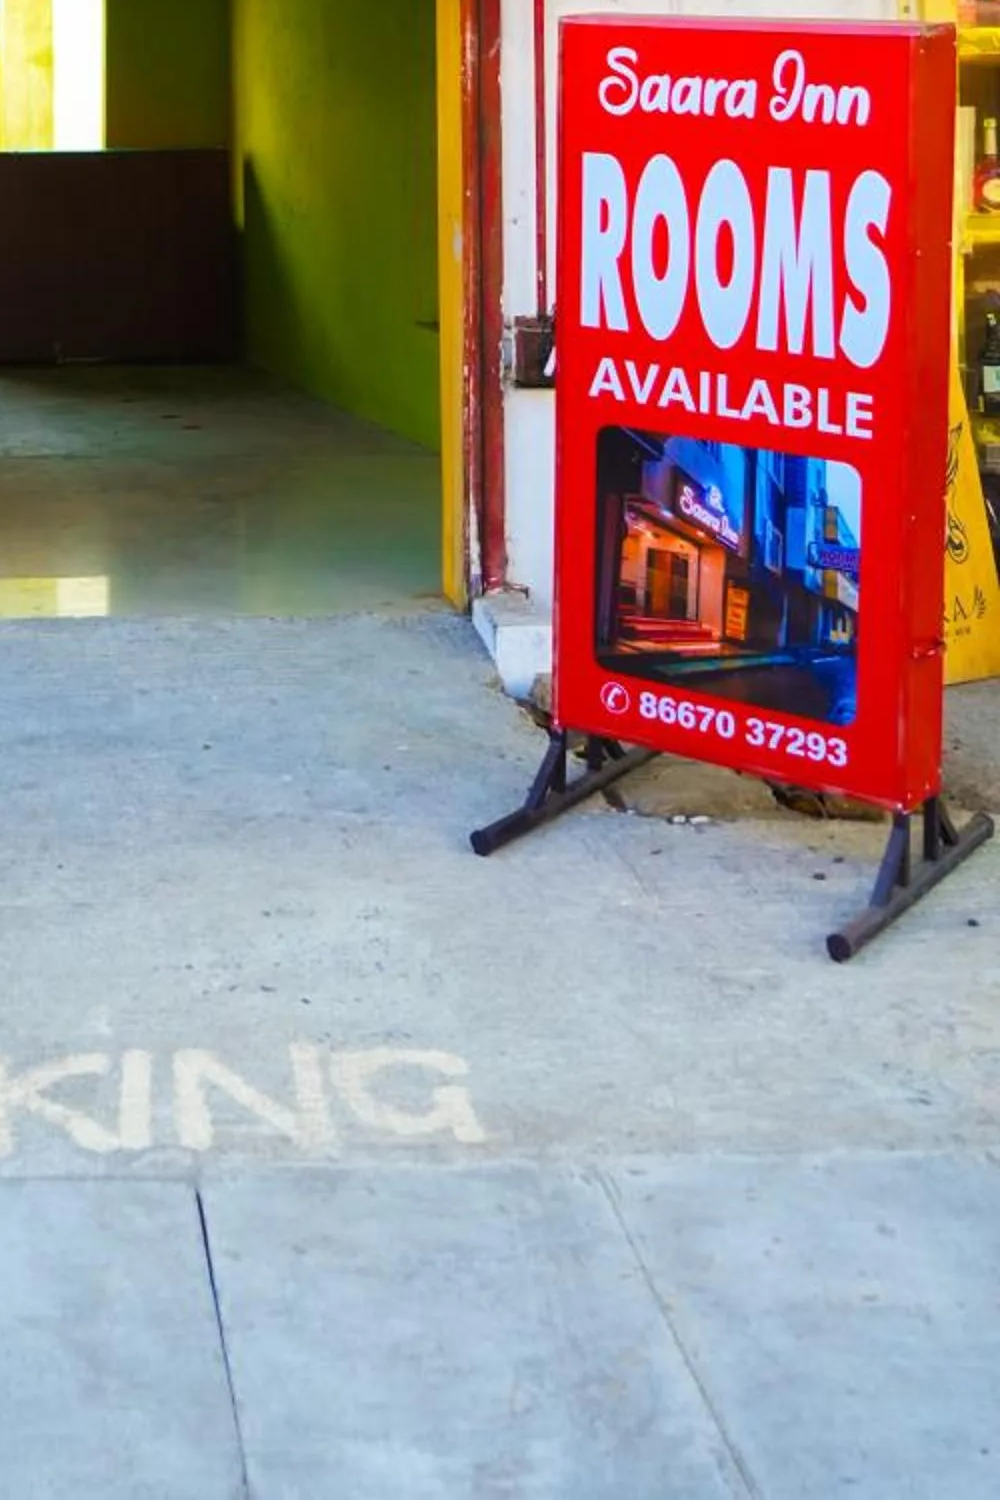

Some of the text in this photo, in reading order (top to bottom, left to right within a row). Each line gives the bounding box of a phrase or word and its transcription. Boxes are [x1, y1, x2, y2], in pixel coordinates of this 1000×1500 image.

[599, 46, 871, 127] Saara Inn
[579, 151, 892, 369] ROOMS
[588, 357, 874, 440] AVAILABLE
[639, 691, 849, 767] 86670 37293
